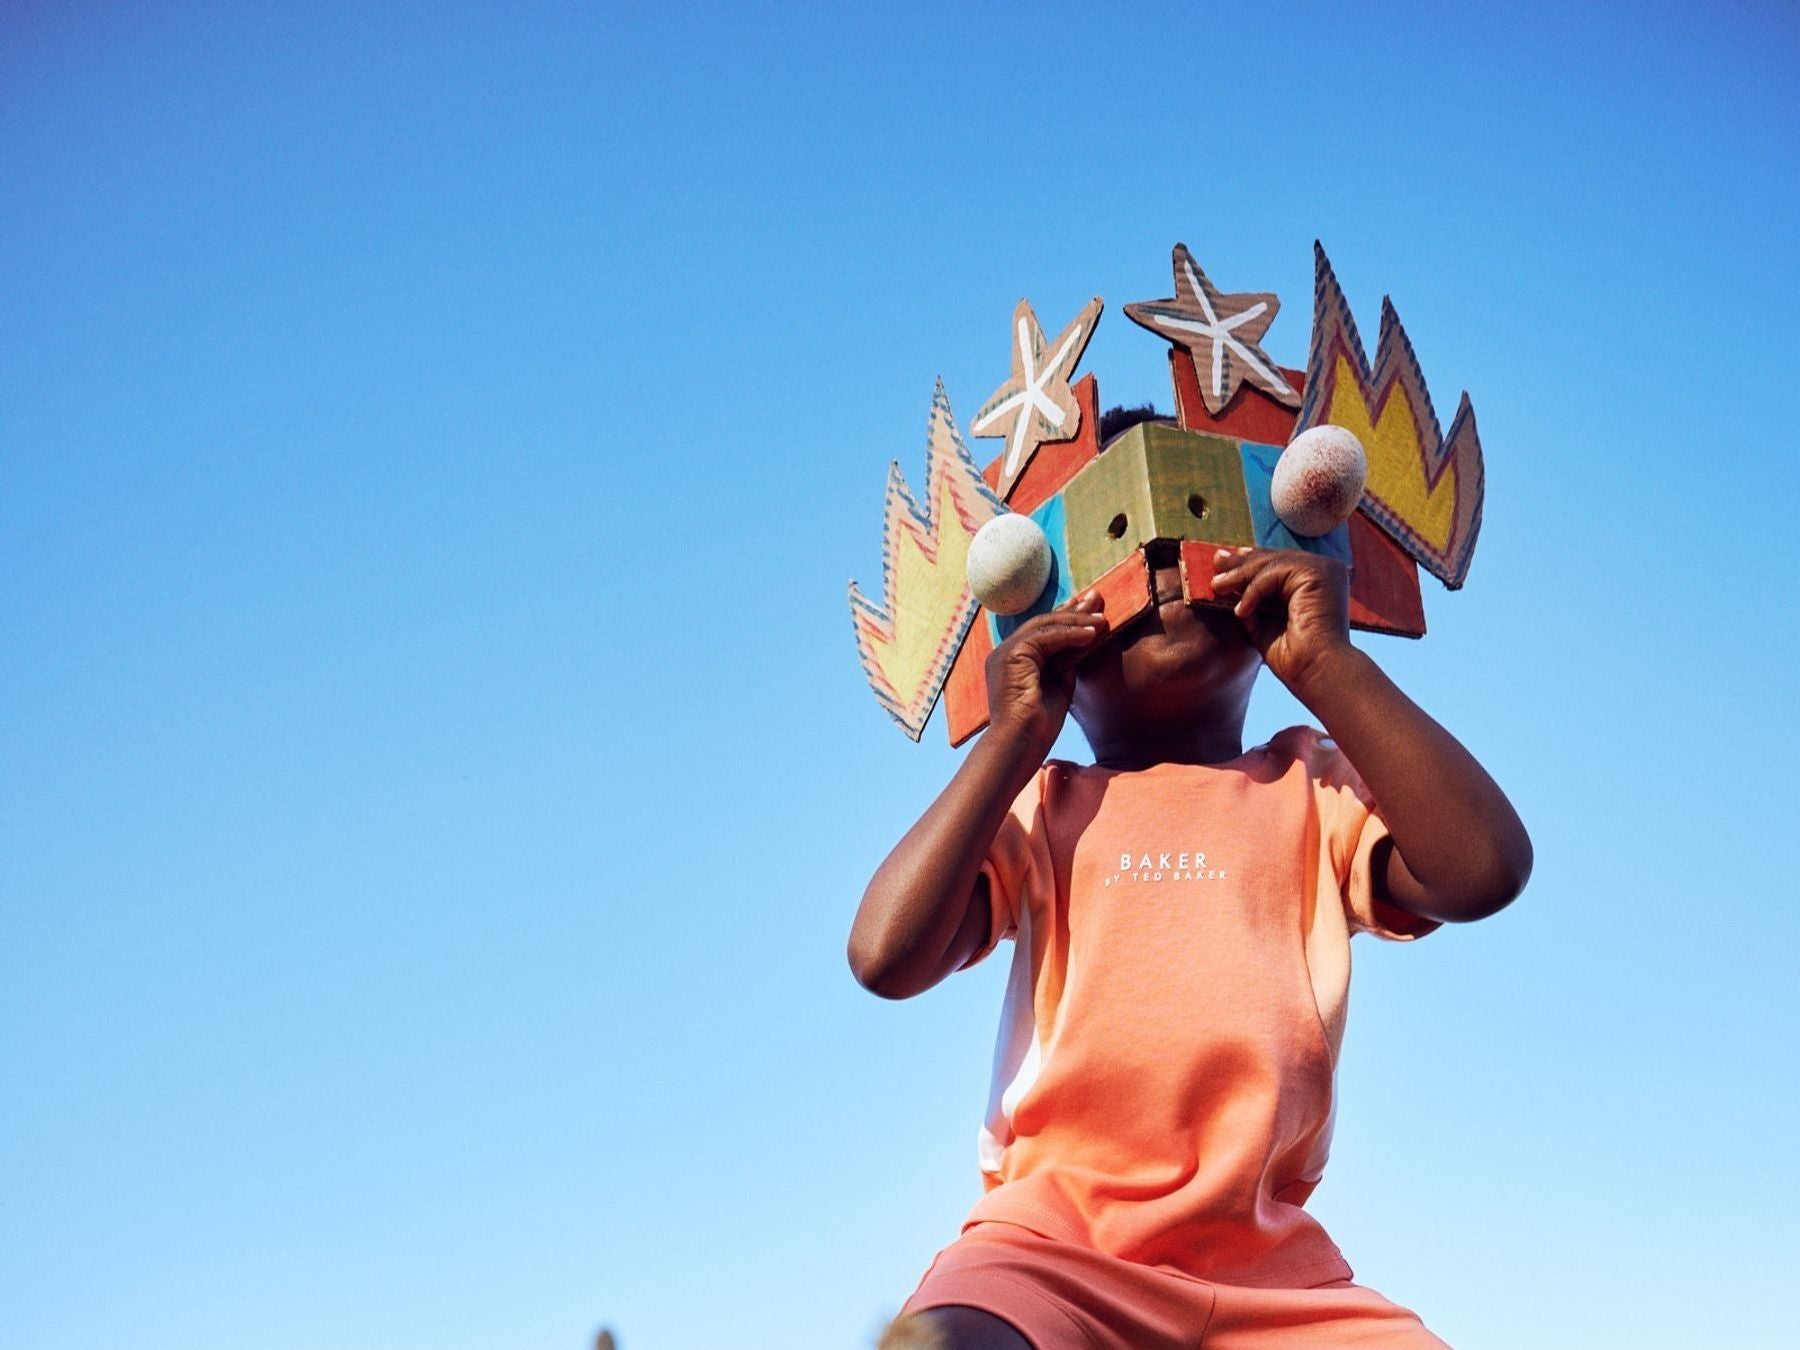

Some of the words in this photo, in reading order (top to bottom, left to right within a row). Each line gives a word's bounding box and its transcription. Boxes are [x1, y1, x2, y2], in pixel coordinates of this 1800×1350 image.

[1120, 853, 1207, 870] BAKER
[1104, 873, 1120, 888] BY
[1132, 872, 1162, 882] TED
[1174, 870, 1227, 881] BAKER
